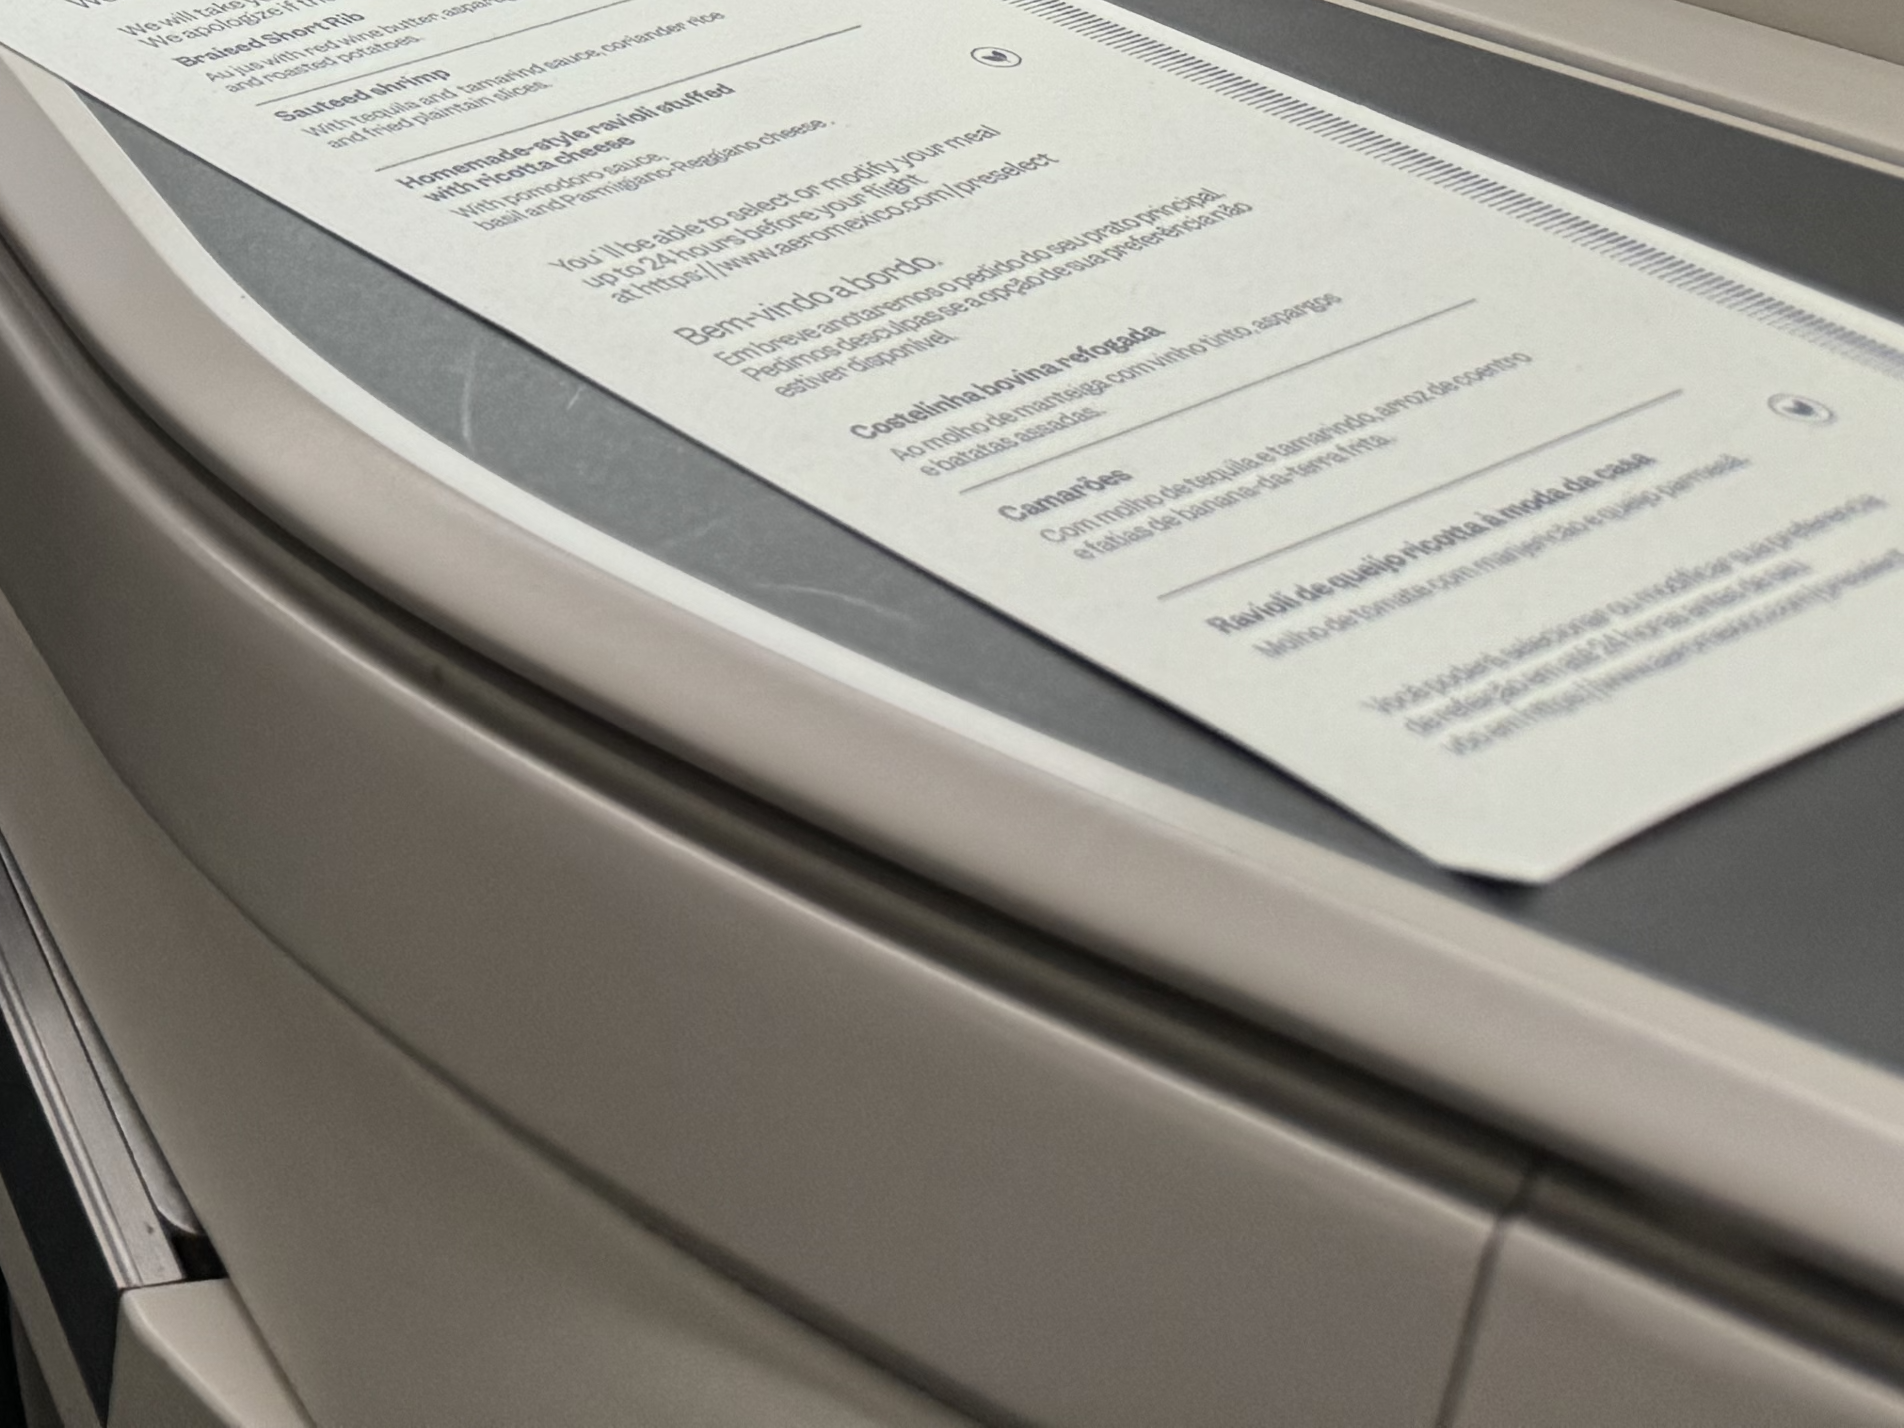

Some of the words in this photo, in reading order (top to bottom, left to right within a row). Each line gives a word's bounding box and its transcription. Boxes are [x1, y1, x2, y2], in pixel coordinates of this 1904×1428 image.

[115, 21, 162, 36] We
[156, 9, 199, 27] will
[192, 0, 246, 18] take
[136, 33, 184, 48] We
[180, 6, 284, 39] apologize
[274, 0, 300, 12] if
[170, 36, 267, 68] Braised
[259, 21, 331, 45] Short
[321, 11, 366, 28] Rib
[272, 87, 374, 122] Sauteed
[368, 68, 451, 96] shrimp
[613, 238, 657, 254] be
[651, 223, 705, 245] able
[696, 214, 730, 230] to
[725, 192, 800, 221] select
[793, 183, 821, 199] or
[819, 159, 900, 191] modify
[891, 142, 946, 169] your
[942, 123, 1001, 150] meal
[610, 287, 644, 304] at
[672, 290, 834, 346] Bem-vindo
[827, 284, 859, 299] a
[848, 390, 987, 440] Costelinha
[969, 362, 1065, 397] bovina
[1053, 325, 1167, 369] refogada
[996, 468, 1135, 523] Camarões
